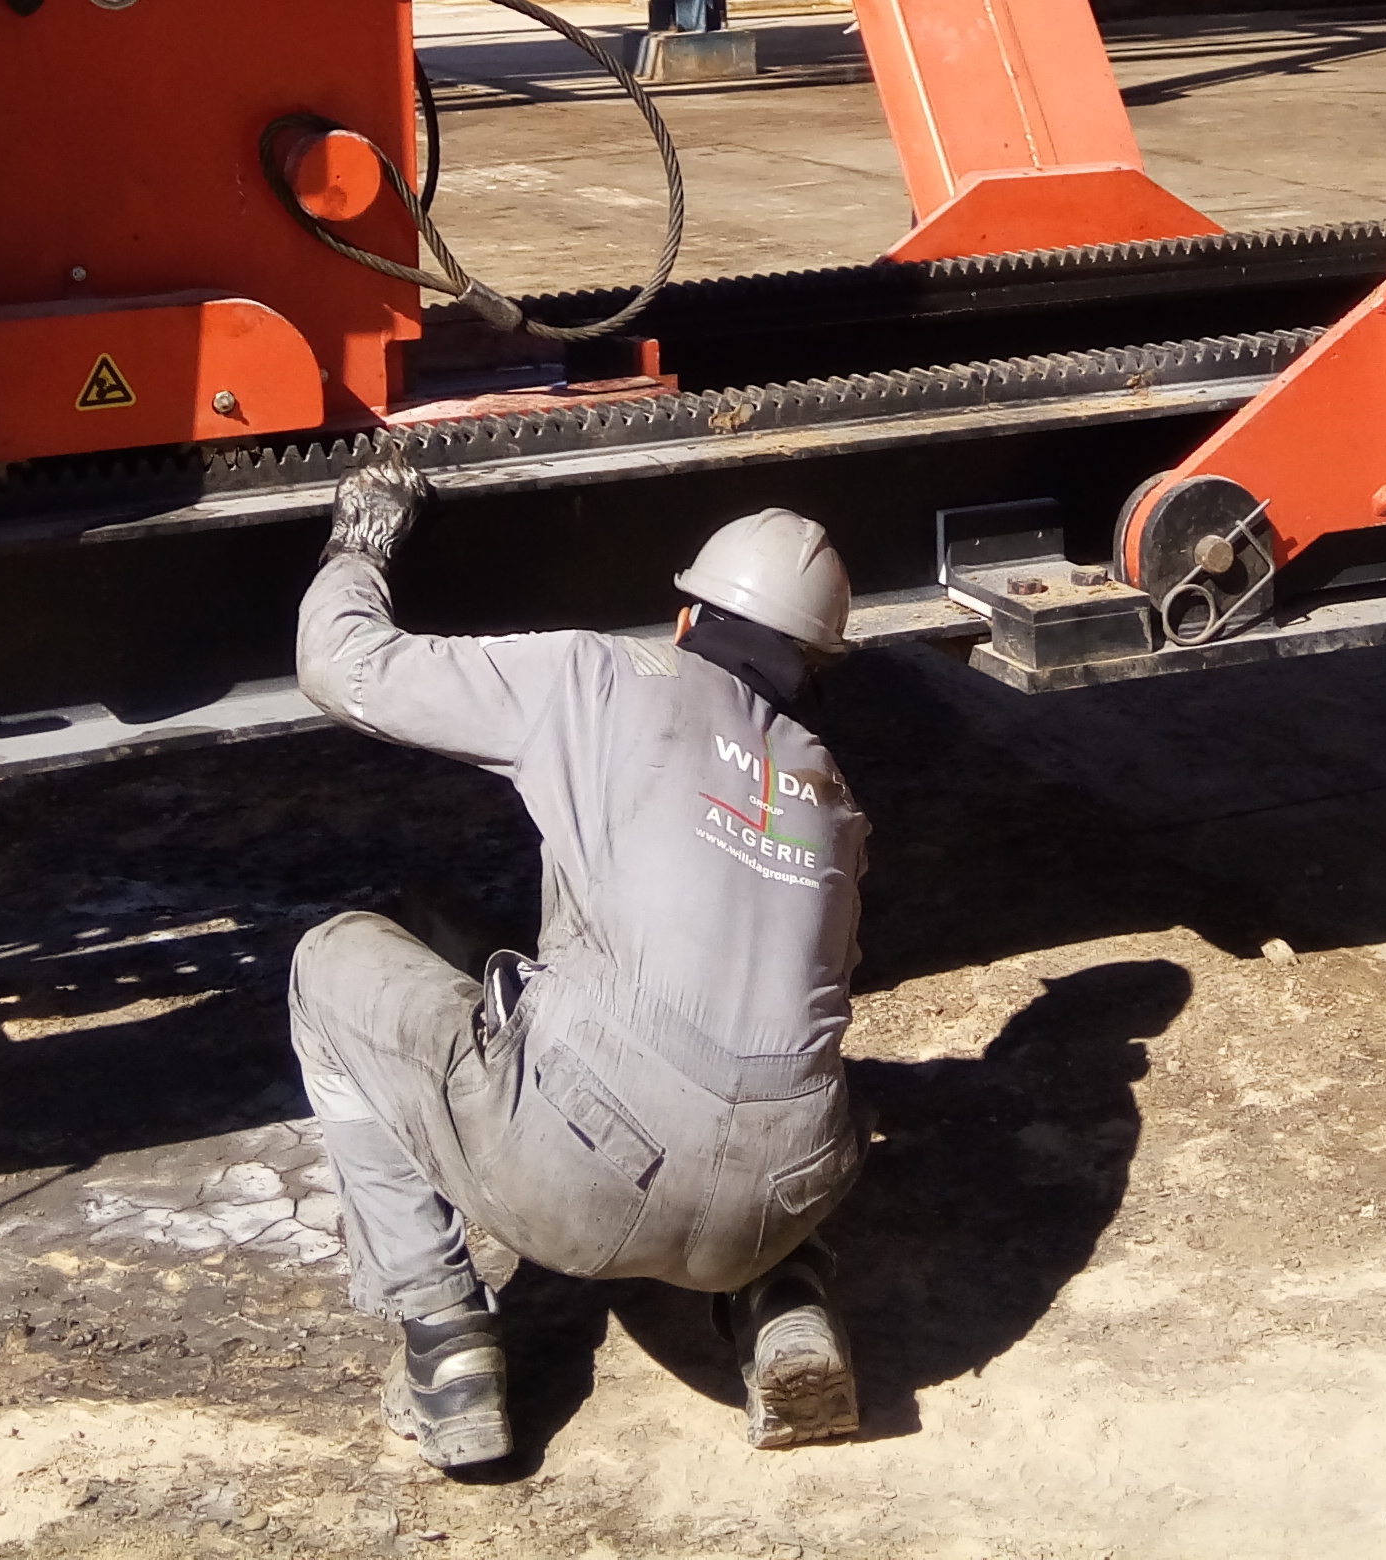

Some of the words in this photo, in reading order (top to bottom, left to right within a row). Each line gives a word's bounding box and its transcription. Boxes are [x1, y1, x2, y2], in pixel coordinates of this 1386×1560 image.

[749, 795, 784, 817] GROUP
[695, 827, 821, 890] www.willdagroup.com
[706, 807, 815, 869] ALGERIE
